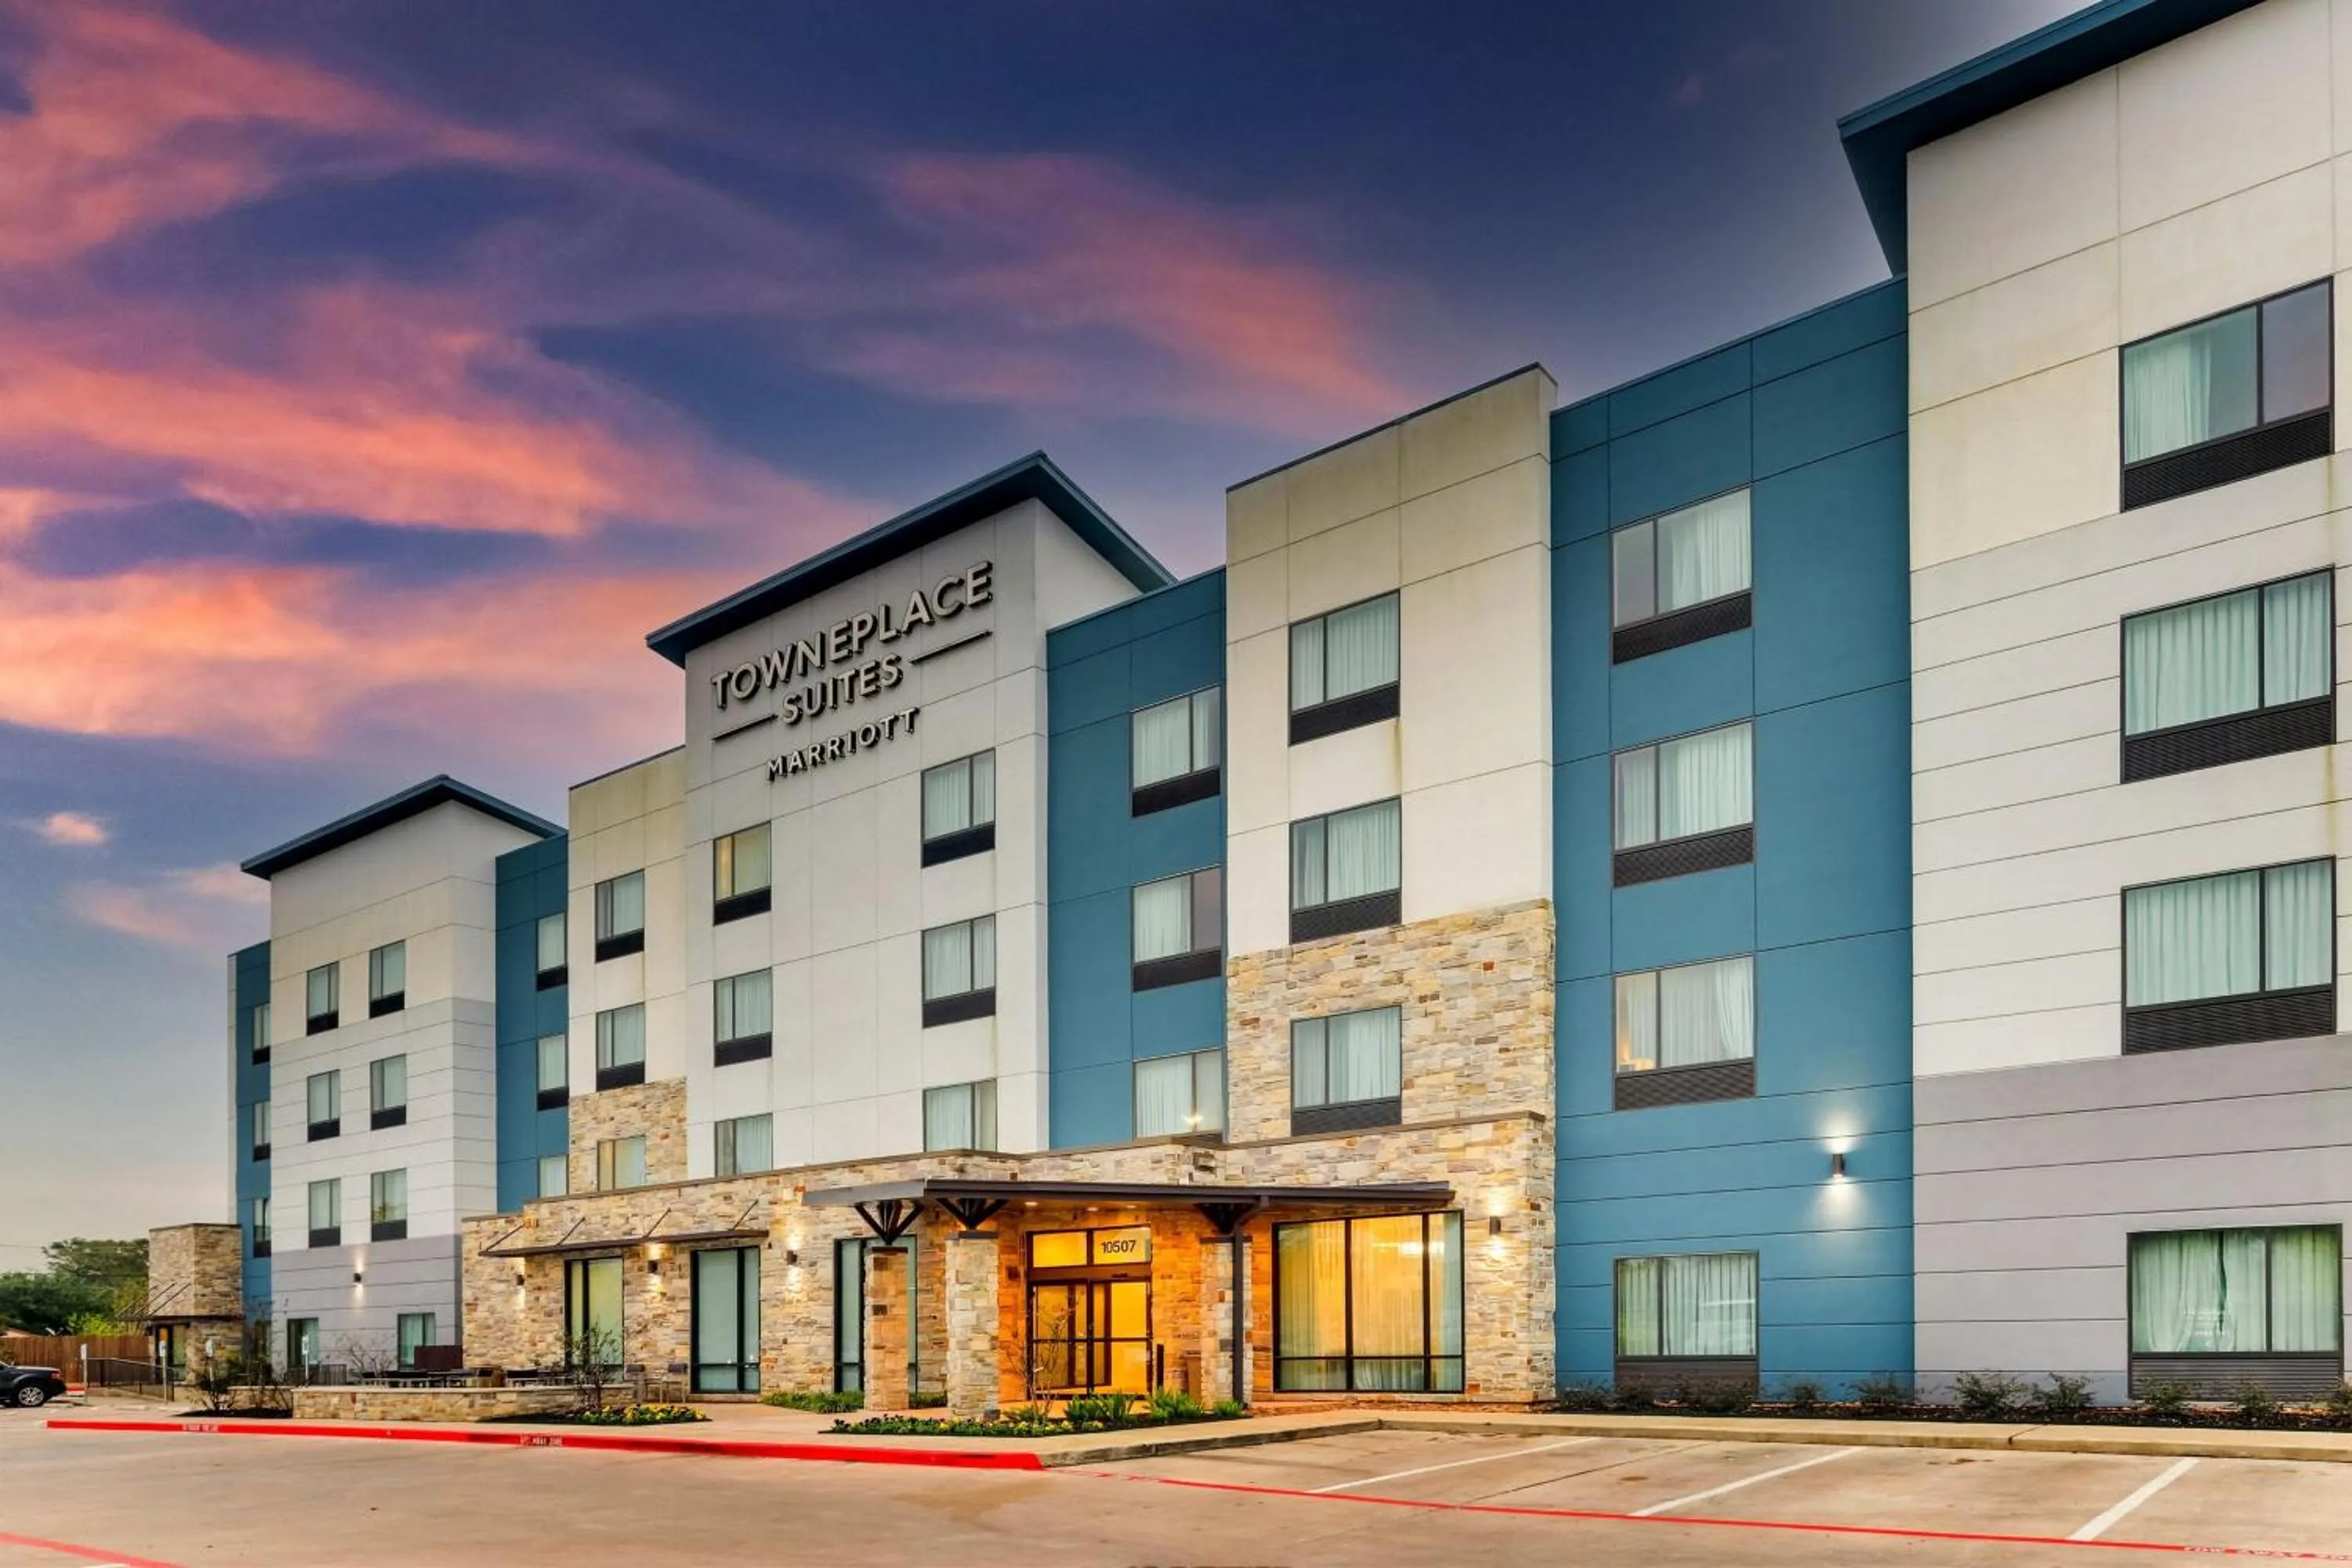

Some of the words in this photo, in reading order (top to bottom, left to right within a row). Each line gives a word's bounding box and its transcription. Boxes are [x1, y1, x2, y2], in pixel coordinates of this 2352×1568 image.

[710, 560, 993, 710] TOWNEPLACE
[782, 652, 903, 725] SUITES
[766, 706, 920, 782] MARRIOTT
[1101, 1240, 1137, 1254] 10507
